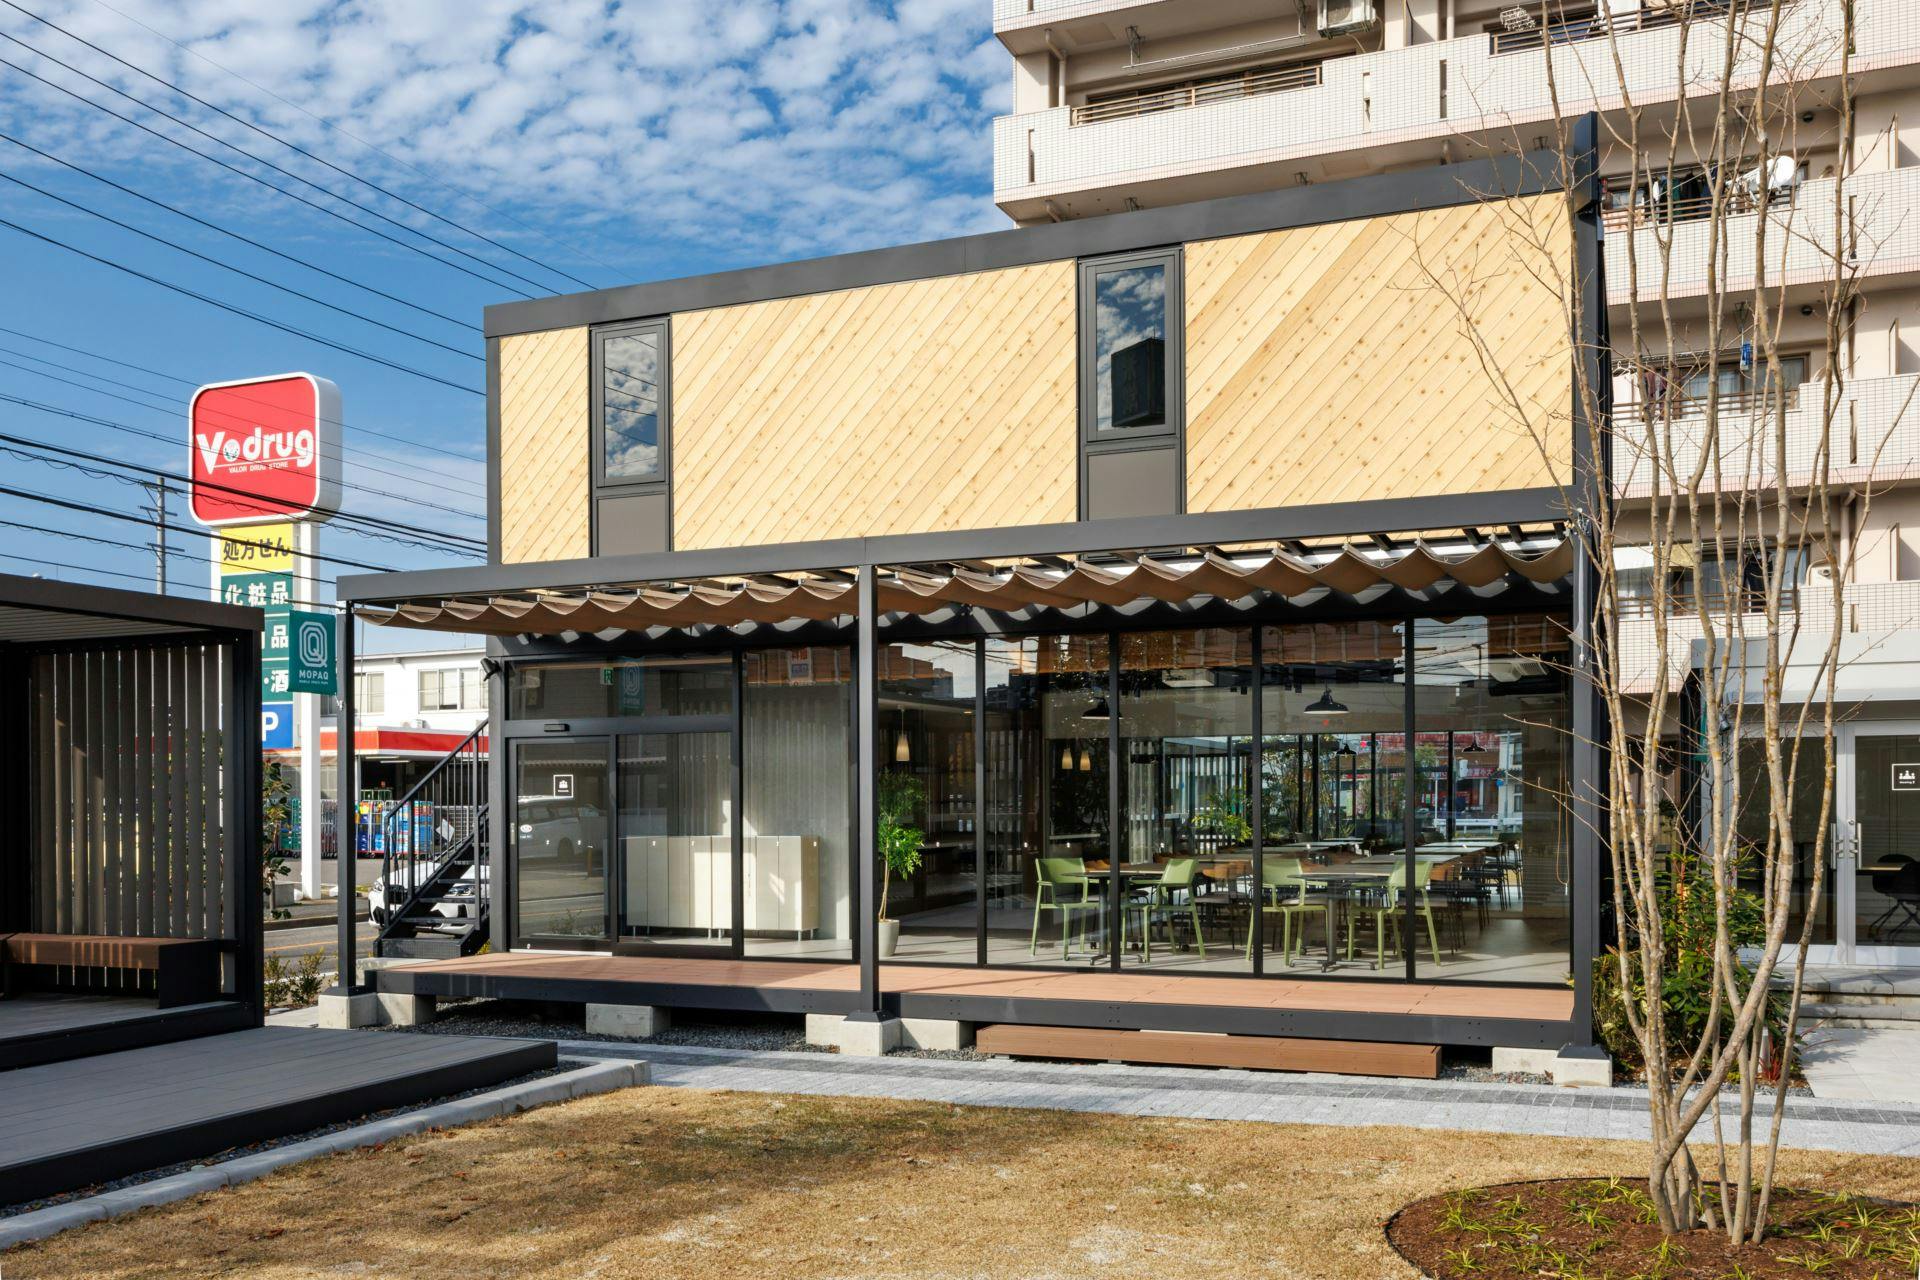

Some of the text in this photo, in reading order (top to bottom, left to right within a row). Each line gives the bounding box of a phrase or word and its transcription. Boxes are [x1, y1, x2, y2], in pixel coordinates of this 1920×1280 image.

[229, 465, 247, 474] VALOR
[268, 461, 288, 470] STORE
[223, 537, 291, 562] 処方せん
[225, 581, 289, 606] 化粧品
[299, 670, 329, 680] MOPAQ
[262, 711, 279, 742] P
